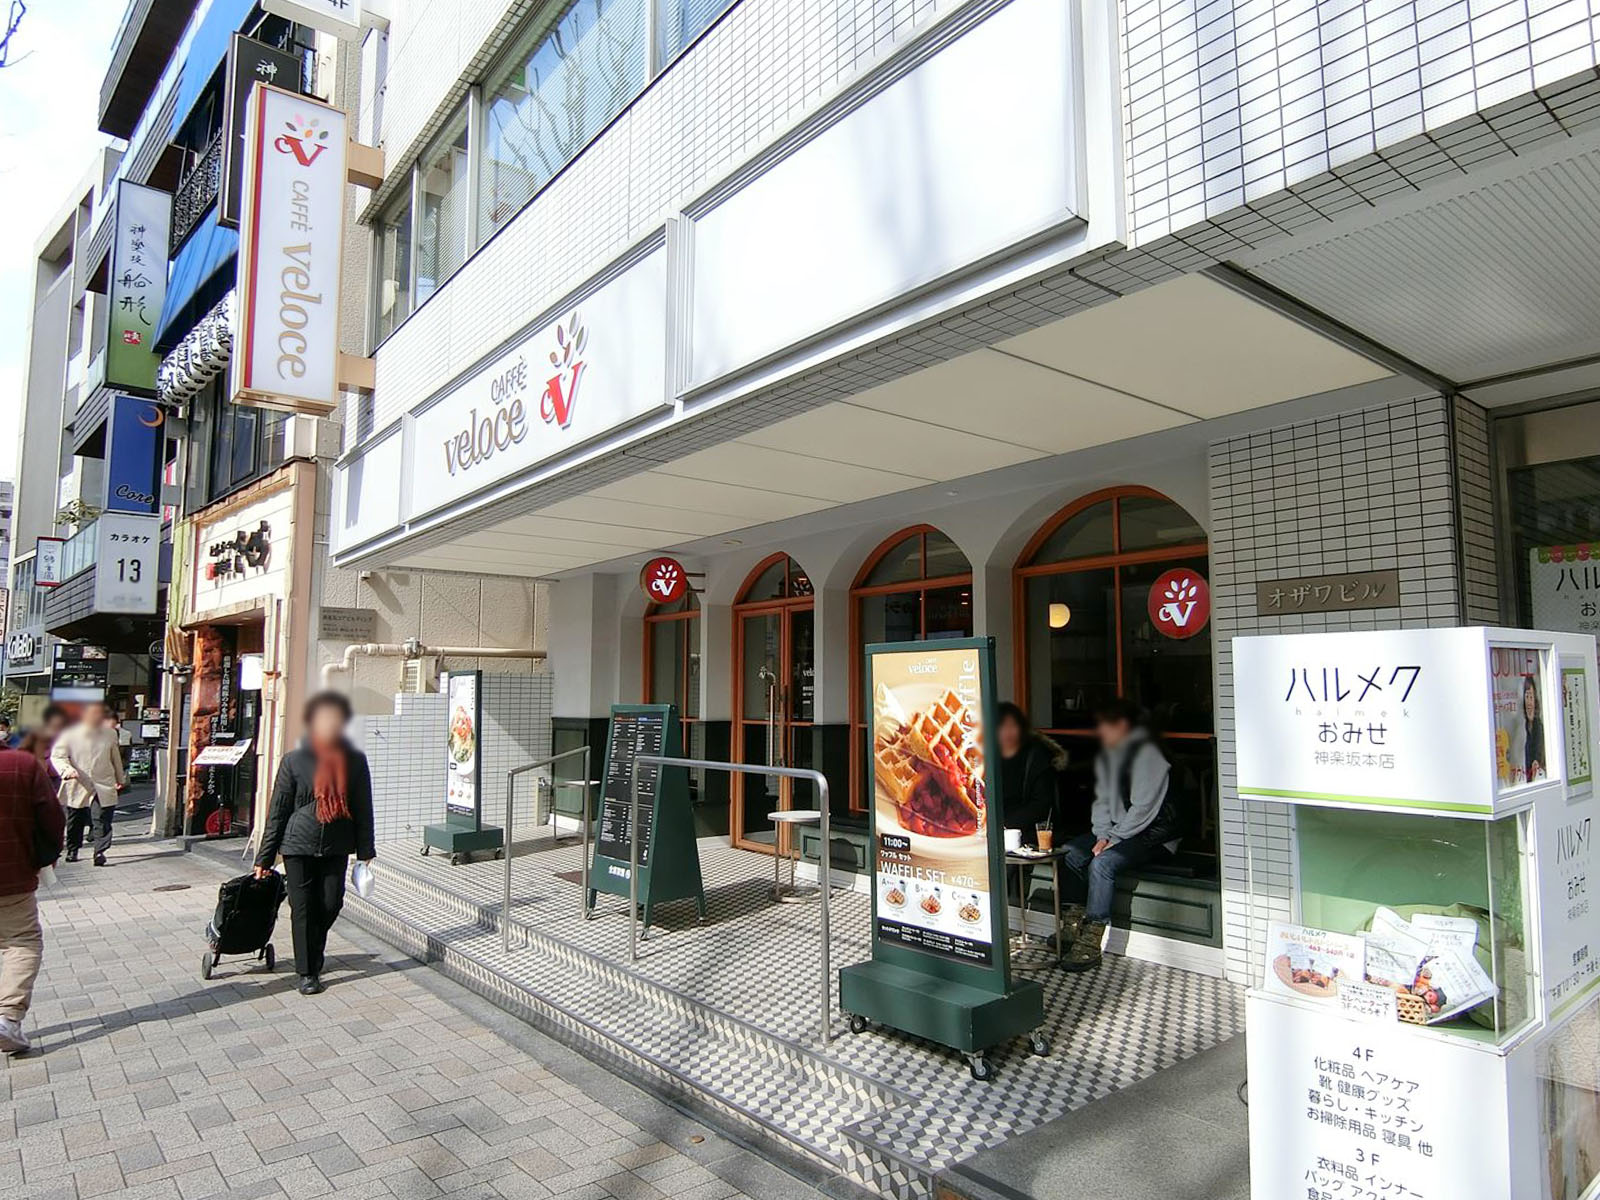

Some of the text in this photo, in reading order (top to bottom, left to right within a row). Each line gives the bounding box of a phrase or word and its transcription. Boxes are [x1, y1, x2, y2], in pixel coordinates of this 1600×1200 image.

[443, 397, 528, 476] veloce
[110, 533, 151, 544] カラオケ
[117, 558, 142, 583] 13
[1268, 580, 1386, 608] オザワビル
[1285, 666, 1421, 702] ハルメク
[1318, 721, 1388, 745] おみせ
[1313, 750, 1395, 769] 神楽坂本店
[1556, 817, 1592, 865] ハルメク
[880, 861, 923, 881] WAFFLE
[925, 868, 947, 885] SET
[1313, 1056, 1420, 1094] 化粧品 ヘアケア
[1318, 1073, 1411, 1112] 靴 健康グッズ
[1307, 1088, 1424, 1133] 暮らし・キッチン
[1306, 1106, 1434, 1158] お掃除用品 寝具 他
[1304, 1168, 1388, 1200] バッグ アク
[1316, 1156, 1425, 1199] 衣料品 インナー
